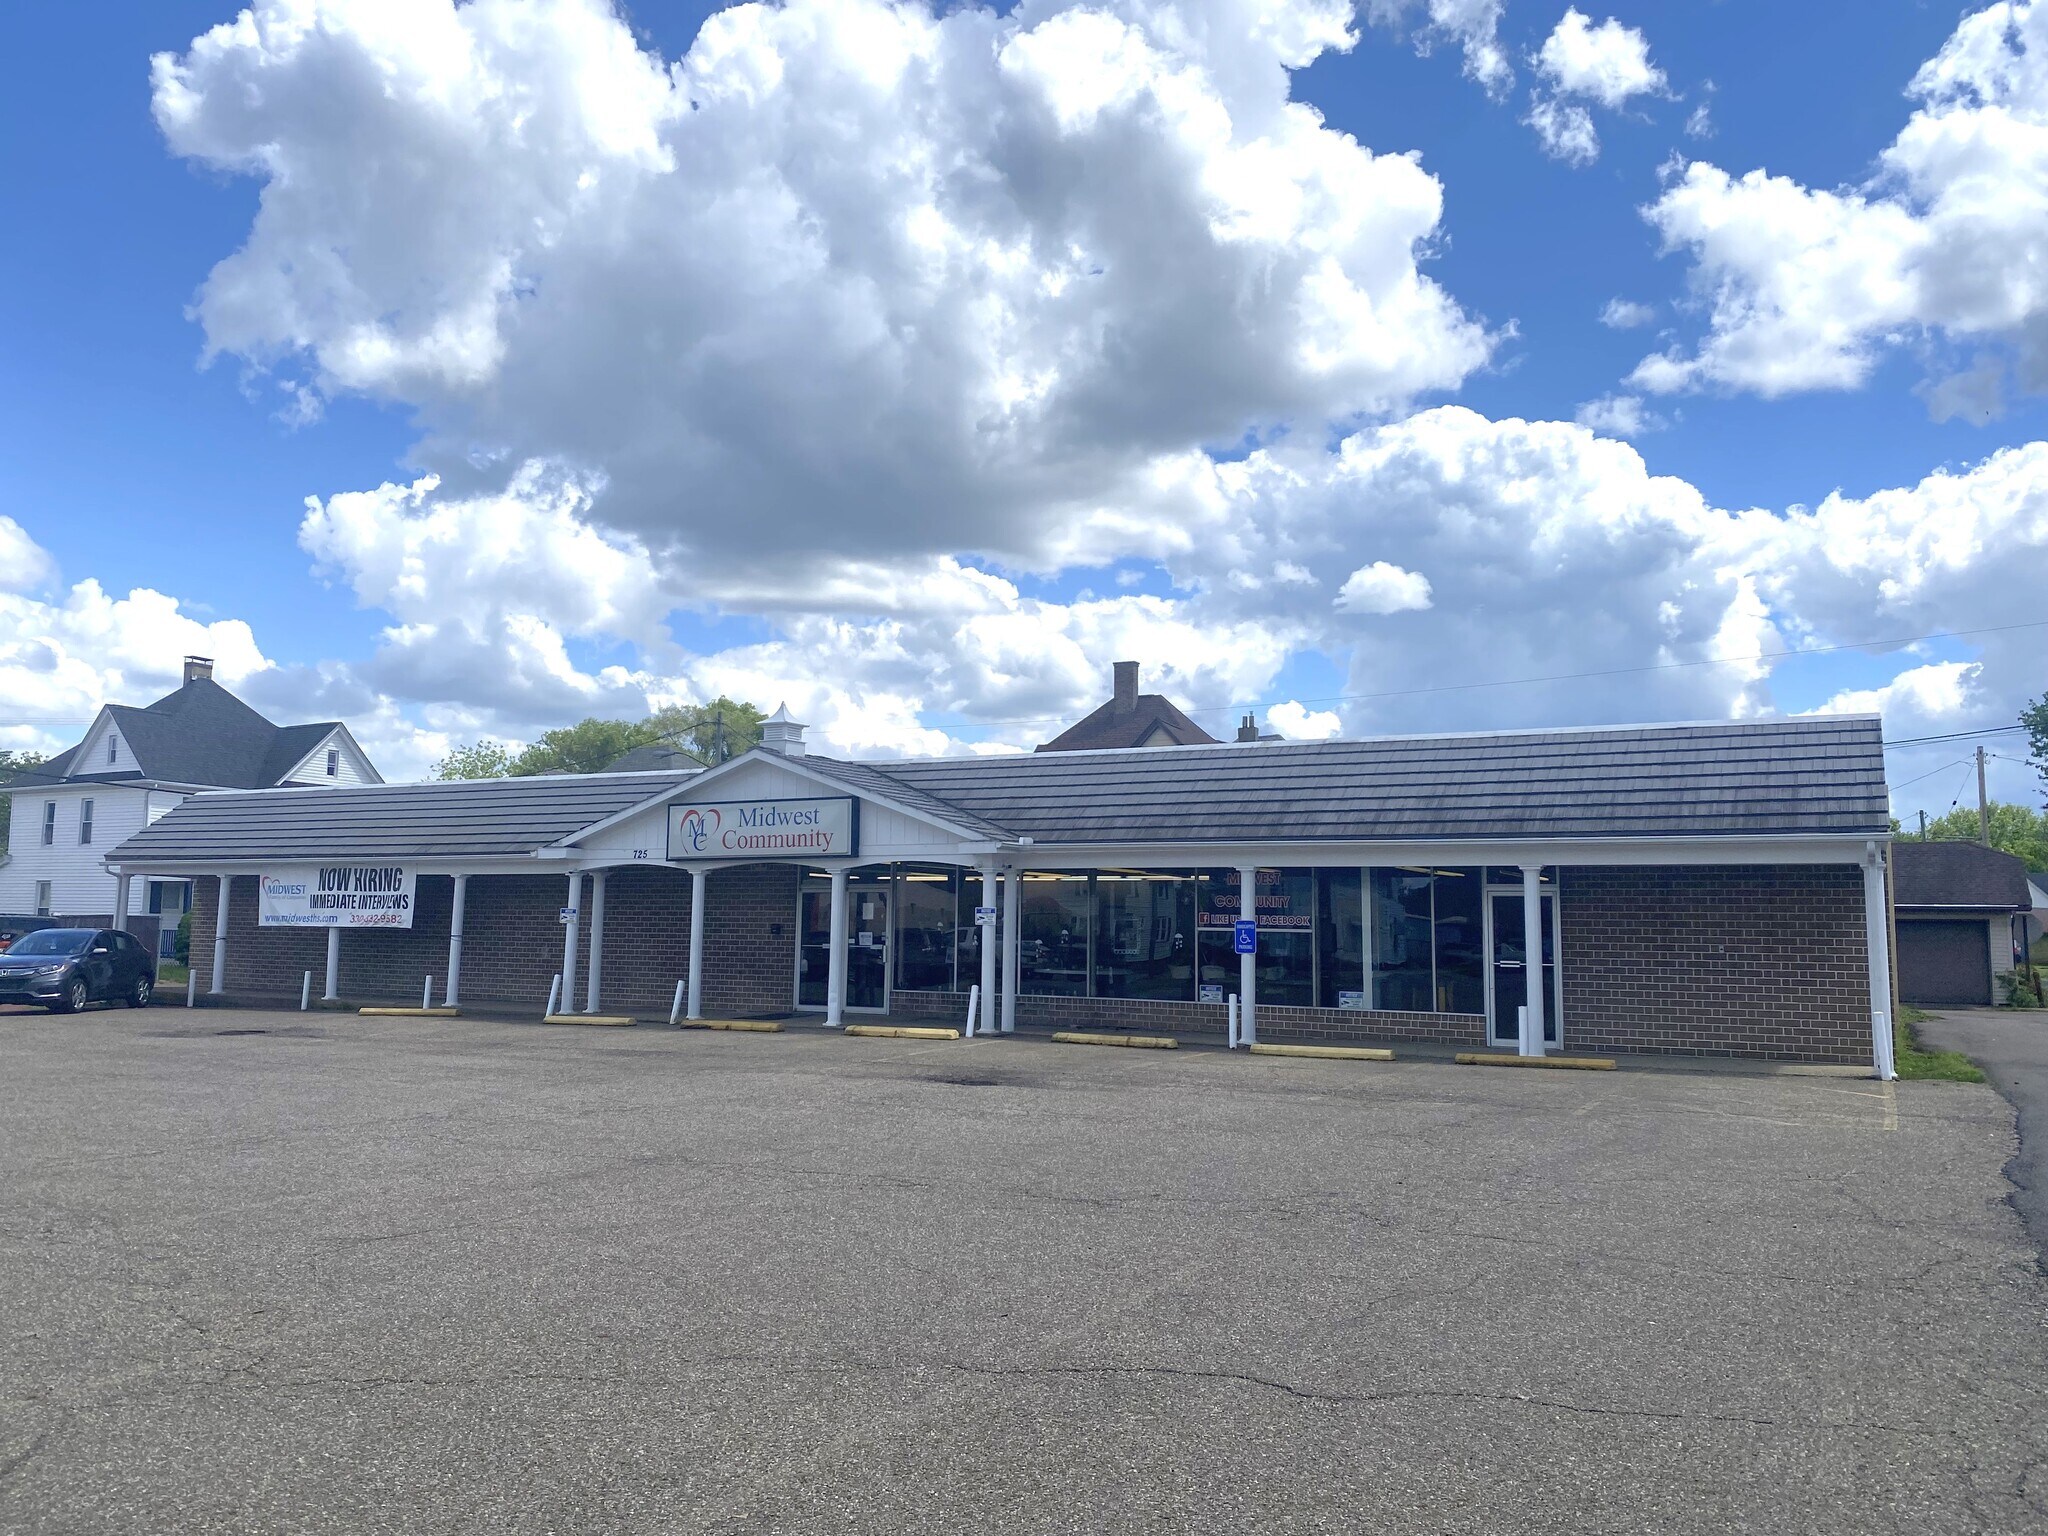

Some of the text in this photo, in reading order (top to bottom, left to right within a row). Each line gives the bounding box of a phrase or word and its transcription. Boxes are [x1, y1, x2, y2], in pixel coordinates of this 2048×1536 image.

[738, 806, 820, 828] Midwest
[722, 829, 834, 852] Community
[633, 850, 648, 859] 725
[317, 867, 403, 892] NOW HIRING
[267, 884, 307, 895] MIDWEST
[309, 894, 409, 910] IMMEDIATE INTERVIEWS
[1211, 914, 1229, 925] LIKE
[1260, 915, 1311, 926] FACEBOOK
